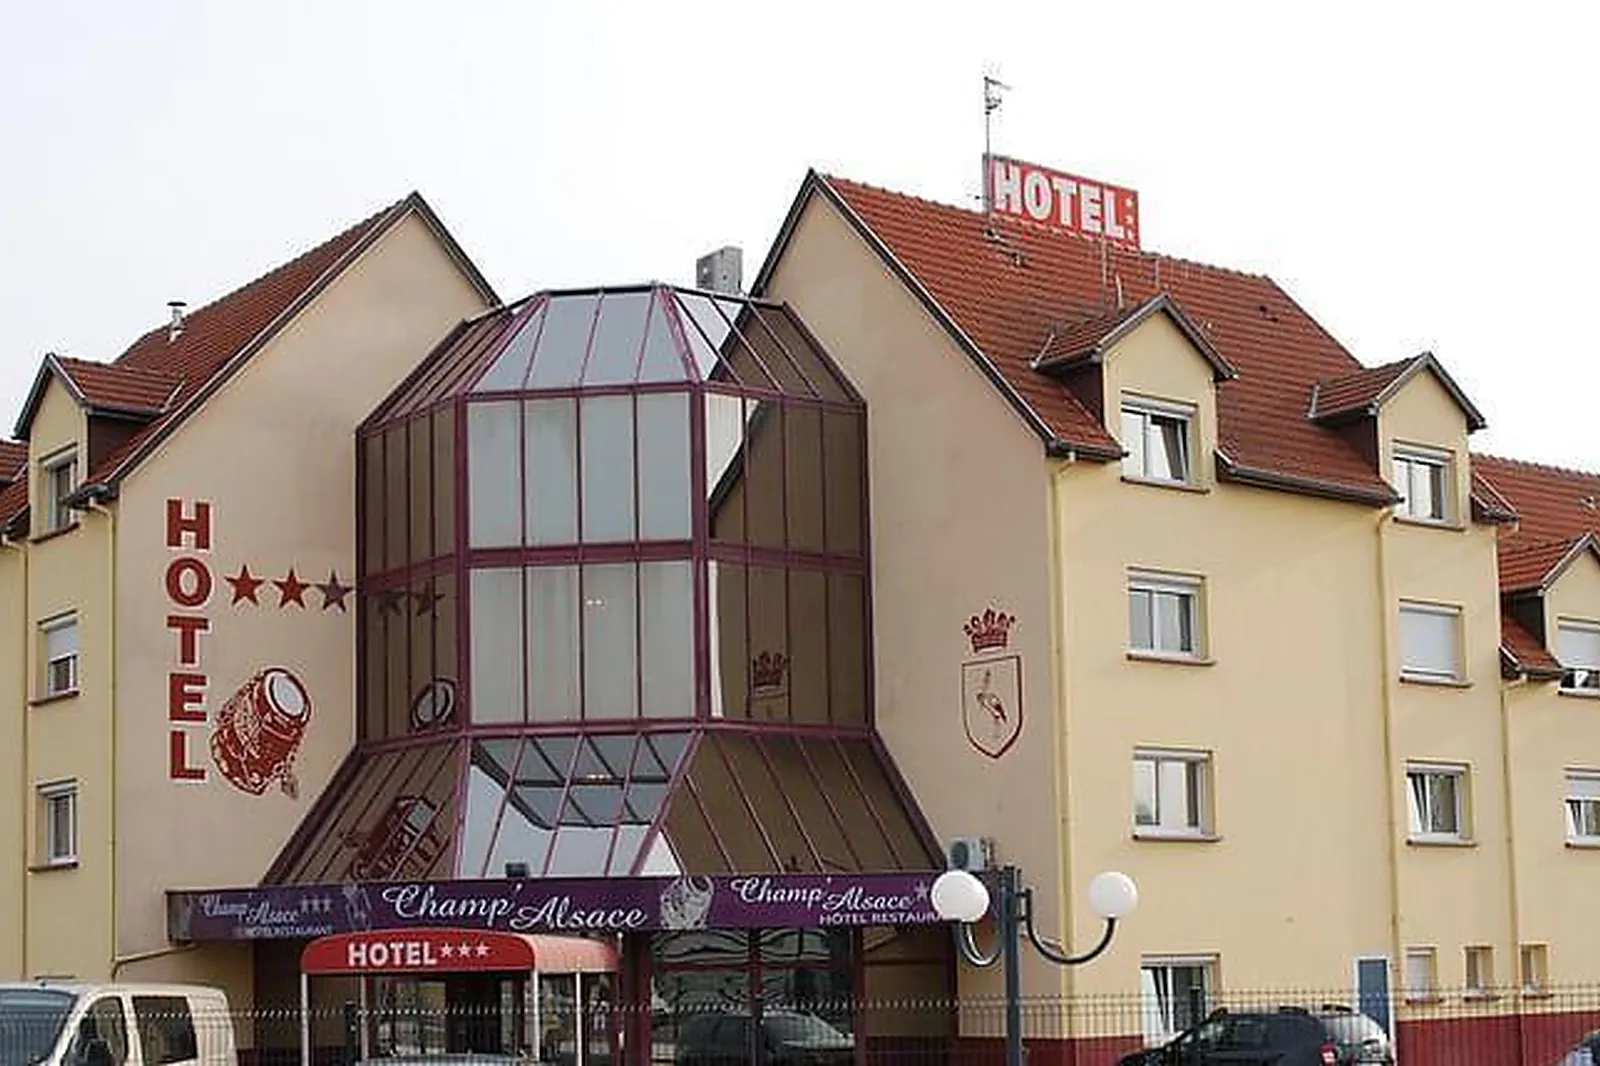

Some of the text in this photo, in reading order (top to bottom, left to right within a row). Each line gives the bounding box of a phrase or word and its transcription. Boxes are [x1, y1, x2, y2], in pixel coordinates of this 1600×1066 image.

[994, 160, 1124, 239] HOTEL
[166, 499, 211, 780] HOTEL
[347, 941, 437, 967] HOTEL
